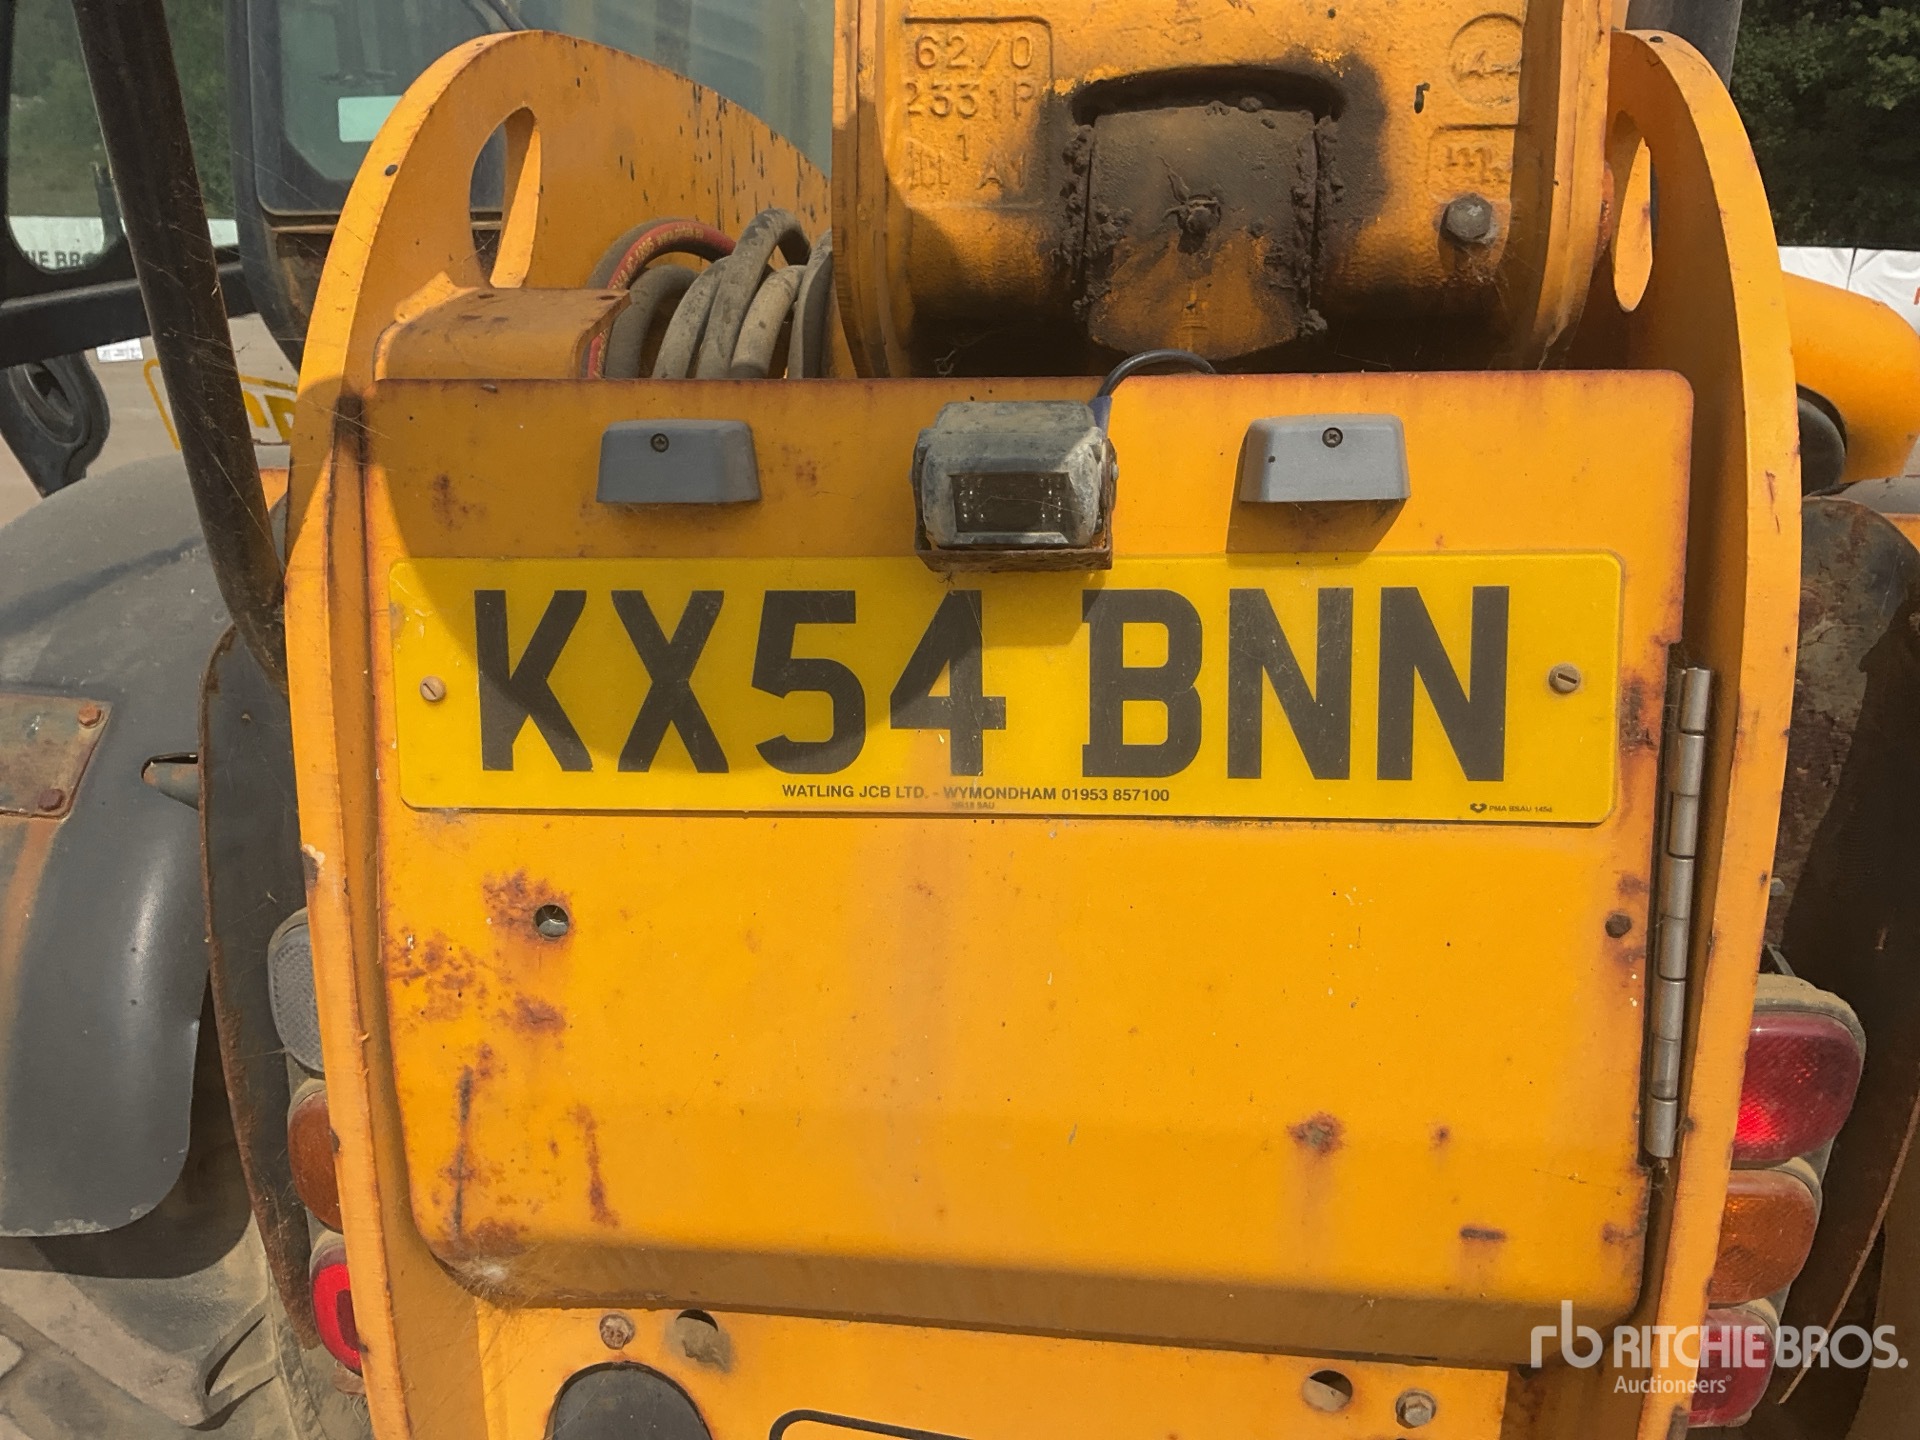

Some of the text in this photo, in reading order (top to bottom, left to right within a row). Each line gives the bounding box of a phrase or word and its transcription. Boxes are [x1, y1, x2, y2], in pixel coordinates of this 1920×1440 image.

[474, 585, 1511, 782] KX54 BNN
[782, 784, 855, 798] WATLING
[859, 785, 891, 798] JCB
[895, 786, 930, 799] LTD.
[943, 785, 1057, 801] WYMONDHAM
[1061, 787, 1109, 801] 01953
[1112, 788, 1170, 802] 857100
